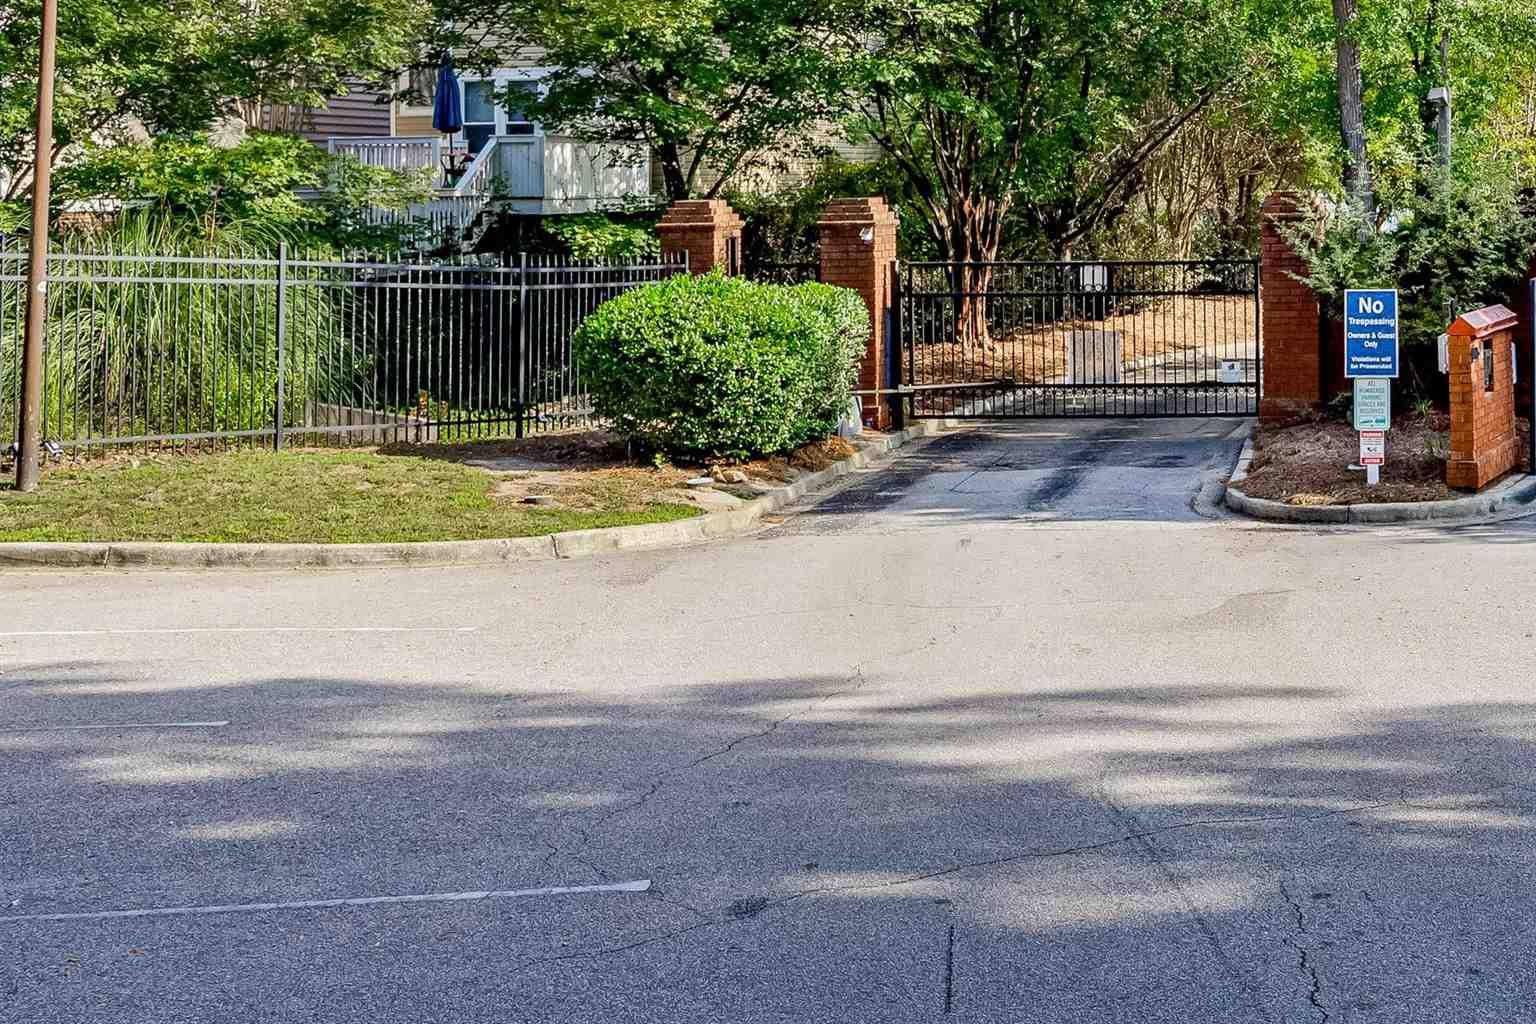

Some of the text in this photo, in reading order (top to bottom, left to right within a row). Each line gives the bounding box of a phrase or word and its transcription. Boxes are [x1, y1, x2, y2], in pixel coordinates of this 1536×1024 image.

[1359, 296, 1384, 314] No
[1348, 317, 1395, 327] Trespassing
[1364, 341, 1378, 349] Only
